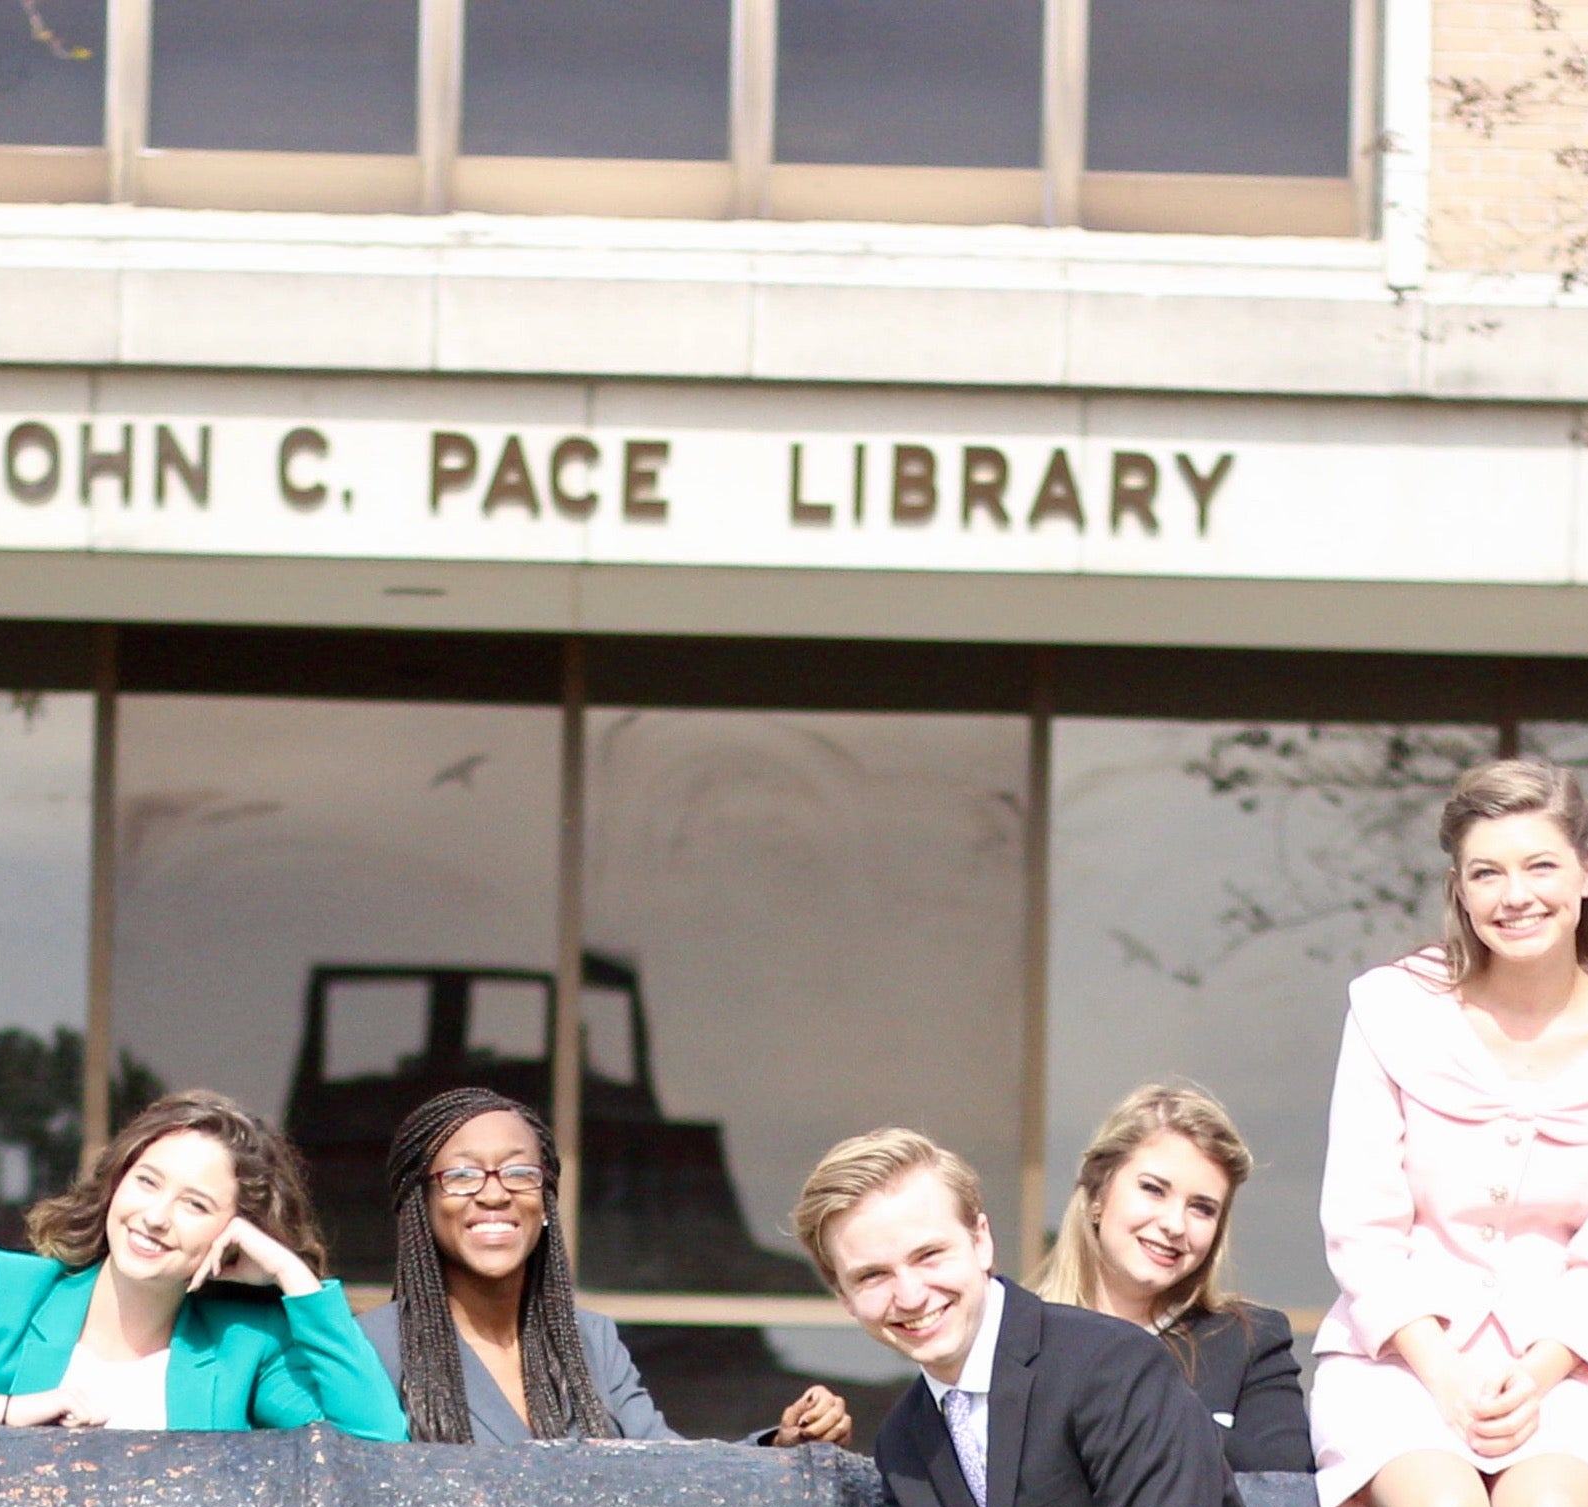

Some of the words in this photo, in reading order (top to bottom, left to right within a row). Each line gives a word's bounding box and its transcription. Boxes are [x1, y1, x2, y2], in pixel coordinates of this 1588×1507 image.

[276, 427, 353, 510] C.
[427, 432, 671, 521] PACE
[788, 442, 1236, 537] LIBRARY
